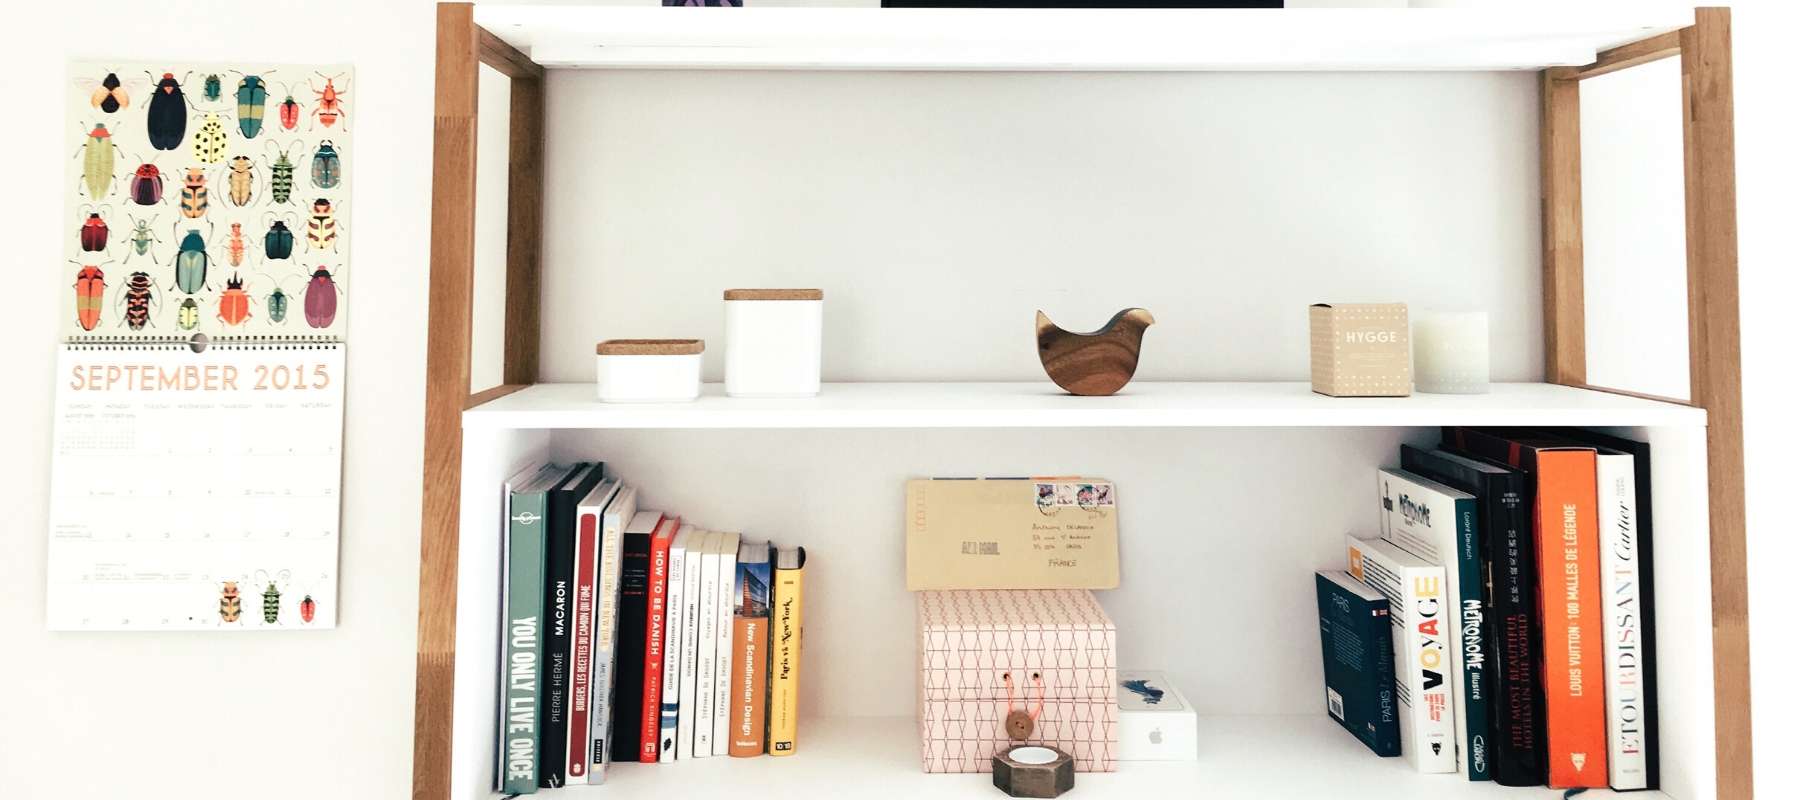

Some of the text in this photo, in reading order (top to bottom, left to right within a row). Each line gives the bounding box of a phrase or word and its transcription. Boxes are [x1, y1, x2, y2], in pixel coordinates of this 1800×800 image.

[1346, 331, 1397, 343] HYGGE
[70, 364, 330, 392] SEPTEMBER 2015
[1613, 500, 1633, 561] Cartier
[554, 581, 566, 636] MACARON
[651, 550, 664, 655] HOW TO BE DANISH
[1561, 504, 1583, 697] LOUIS VUITTON 100 MALLES DE LÉGENDE
[747, 623, 755, 642] New
[1505, 614, 1519, 681] BEAUTIFUL
[1518, 613, 1529, 656] WORLD
[577, 645, 588, 673] RECETTES
[744, 645, 755, 703] Scandinavian
[780, 658, 790, 680] Paris
[1614, 568, 1639, 754] ETOURDISSANT
[551, 652, 564, 722] PIERRE HERMÉ
[576, 673, 587, 684] LES
[508, 616, 537, 781] YOU ONLY LIVE ONCE
[1380, 690, 1393, 723] PARIS
[1509, 686, 1521, 720] MOST
[742, 705, 753, 736] Design
[1511, 723, 1522, 747] THE
